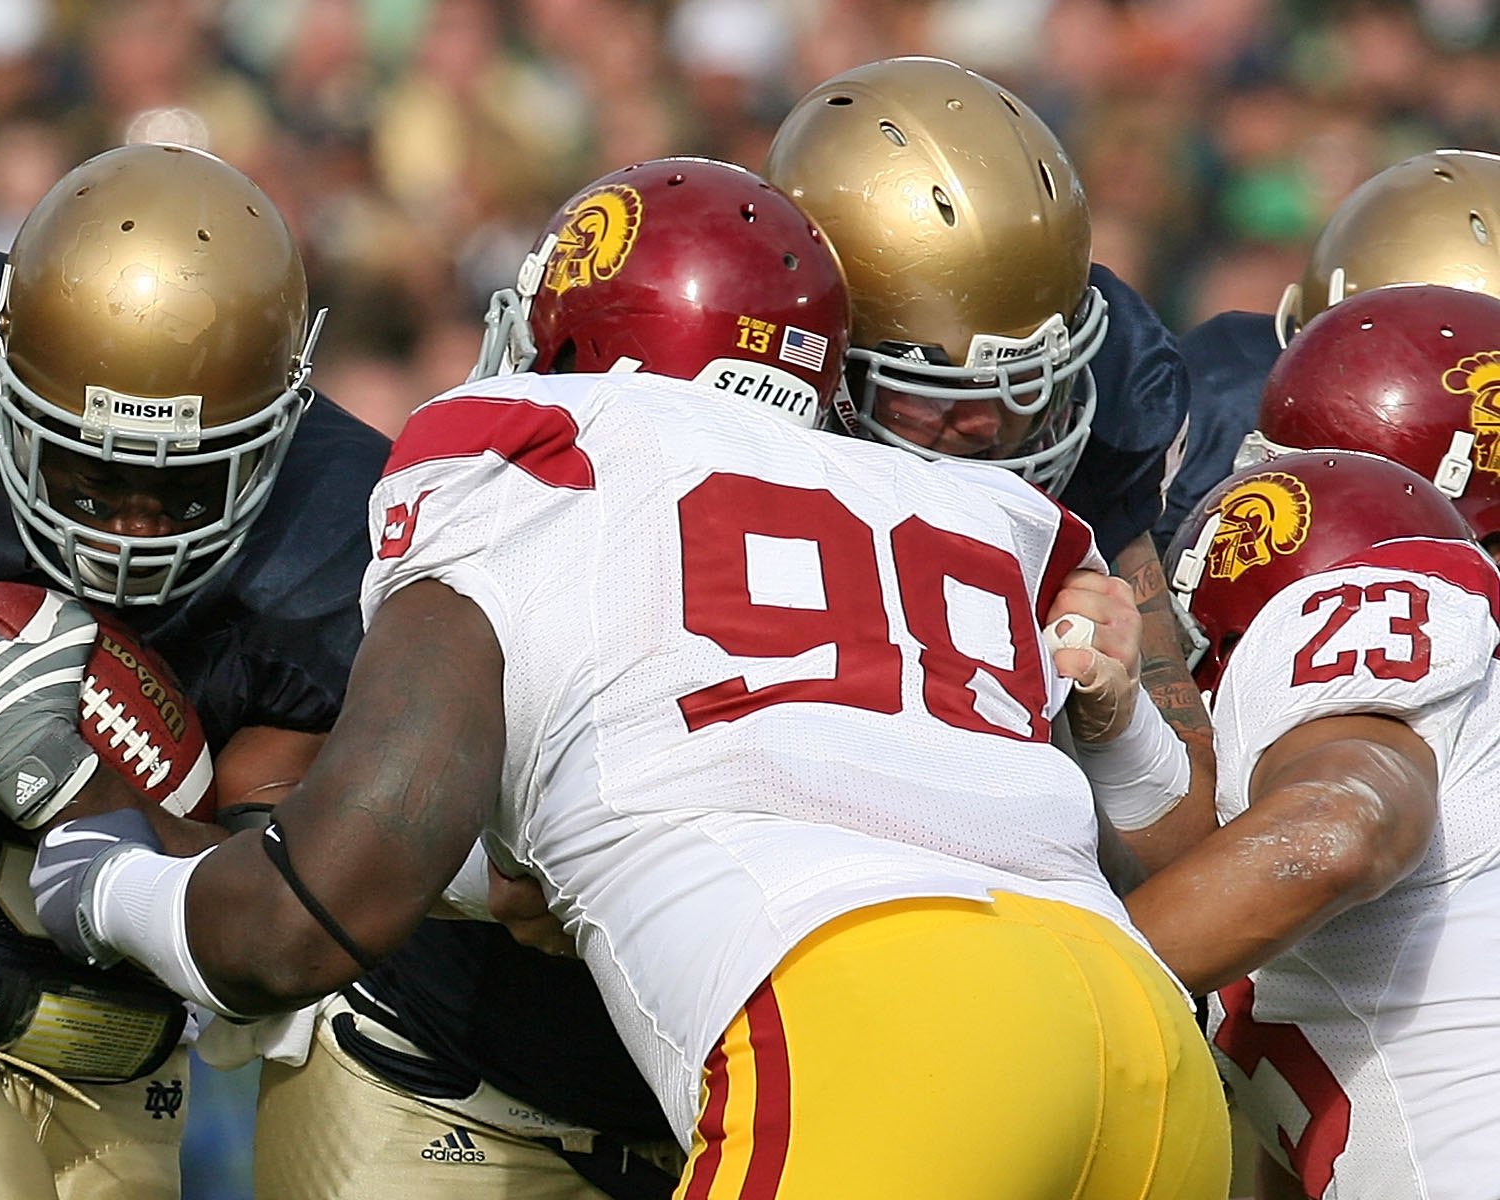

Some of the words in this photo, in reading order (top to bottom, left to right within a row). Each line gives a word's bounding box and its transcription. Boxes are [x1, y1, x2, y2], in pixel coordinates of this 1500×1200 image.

[736, 326, 771, 354] 13
[114, 401, 173, 418] IRISH
[714, 370, 813, 417] schutt
[676, 470, 1054, 748] 98
[1290, 580, 1432, 688] 23
[102, 635, 186, 742] Wilson
[16, 776, 49, 806] adidas
[420, 1147, 486, 1163] adidas
